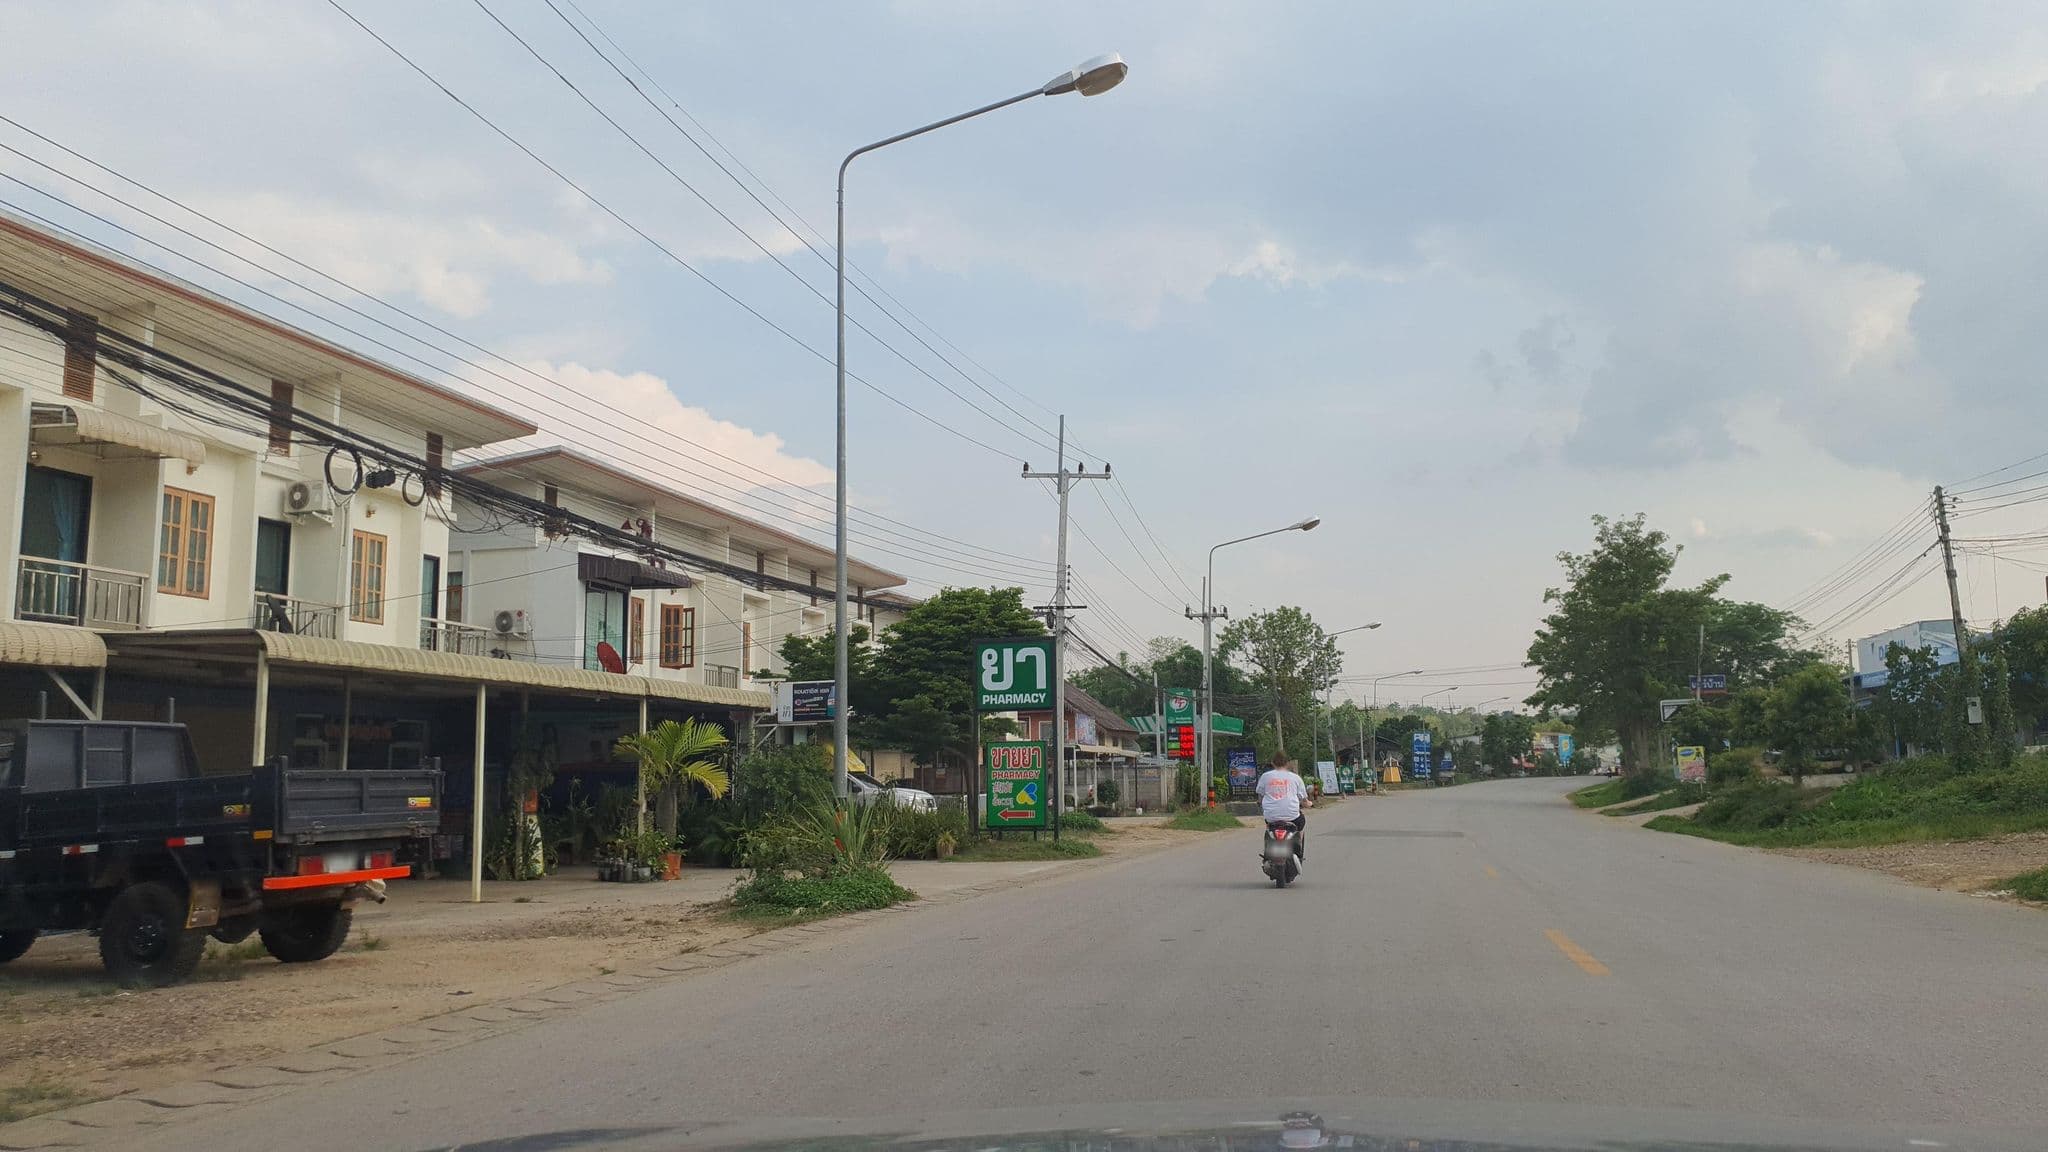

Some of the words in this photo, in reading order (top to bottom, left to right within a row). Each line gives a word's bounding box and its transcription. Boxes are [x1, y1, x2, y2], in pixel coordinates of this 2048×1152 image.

[981, 646, 1047, 691] ยา
[982, 692, 1047, 705] PHARMACY
[991, 746, 1042, 769] ขายยา
[991, 769, 1041, 780] PHARMACY
